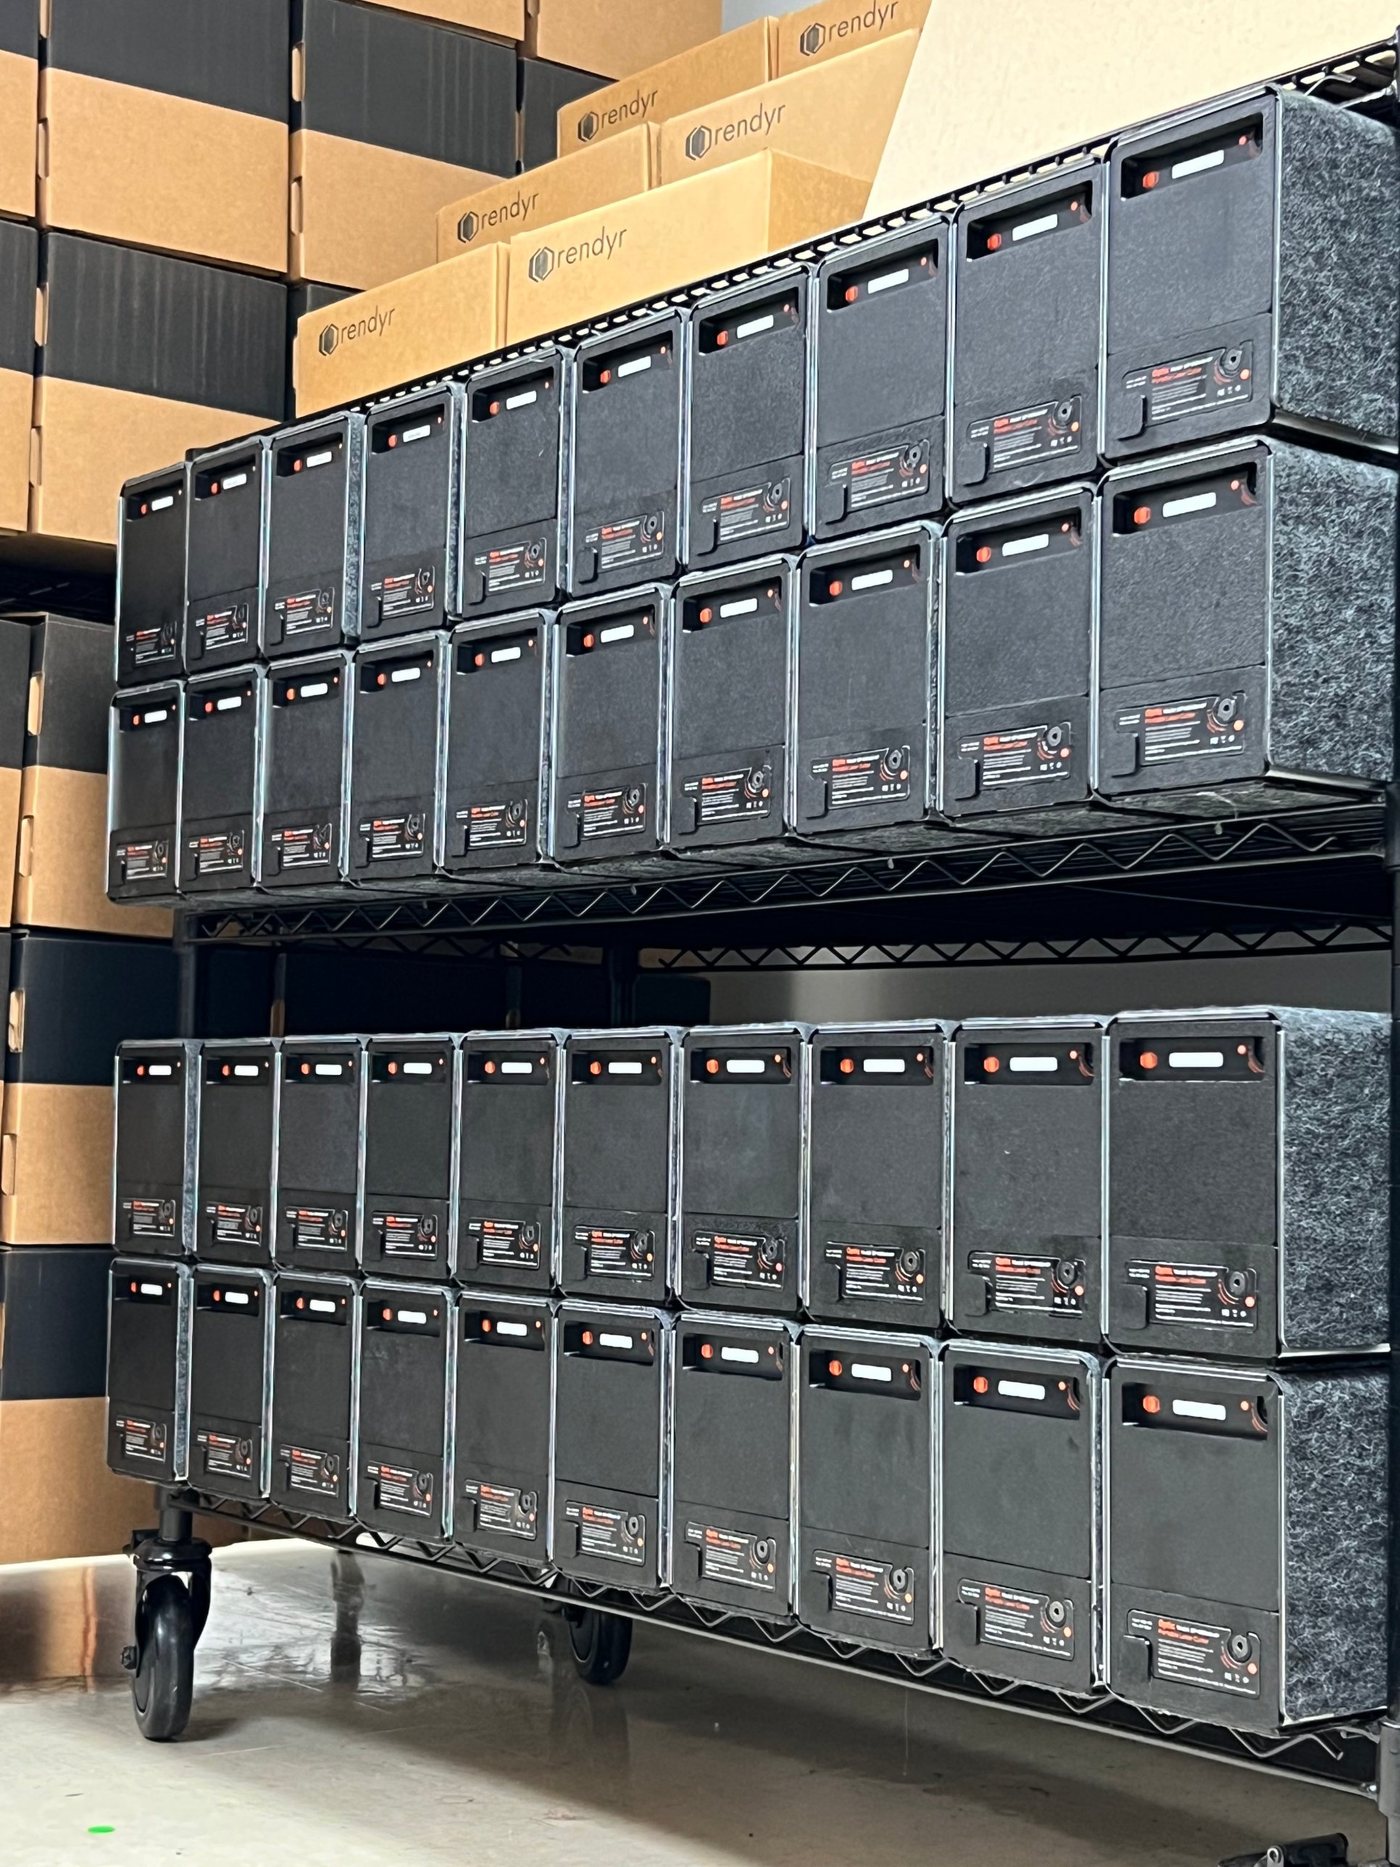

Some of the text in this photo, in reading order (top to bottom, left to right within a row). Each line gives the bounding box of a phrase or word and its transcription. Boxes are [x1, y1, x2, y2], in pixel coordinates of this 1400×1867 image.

[829, 0, 898, 42] rendyr
[602, 89, 658, 128] rendyr
[715, 102, 786, 145] rendyr
[481, 190, 539, 230] rendyr
[558, 226, 627, 268] rendyr
[341, 305, 395, 344] rendyr
